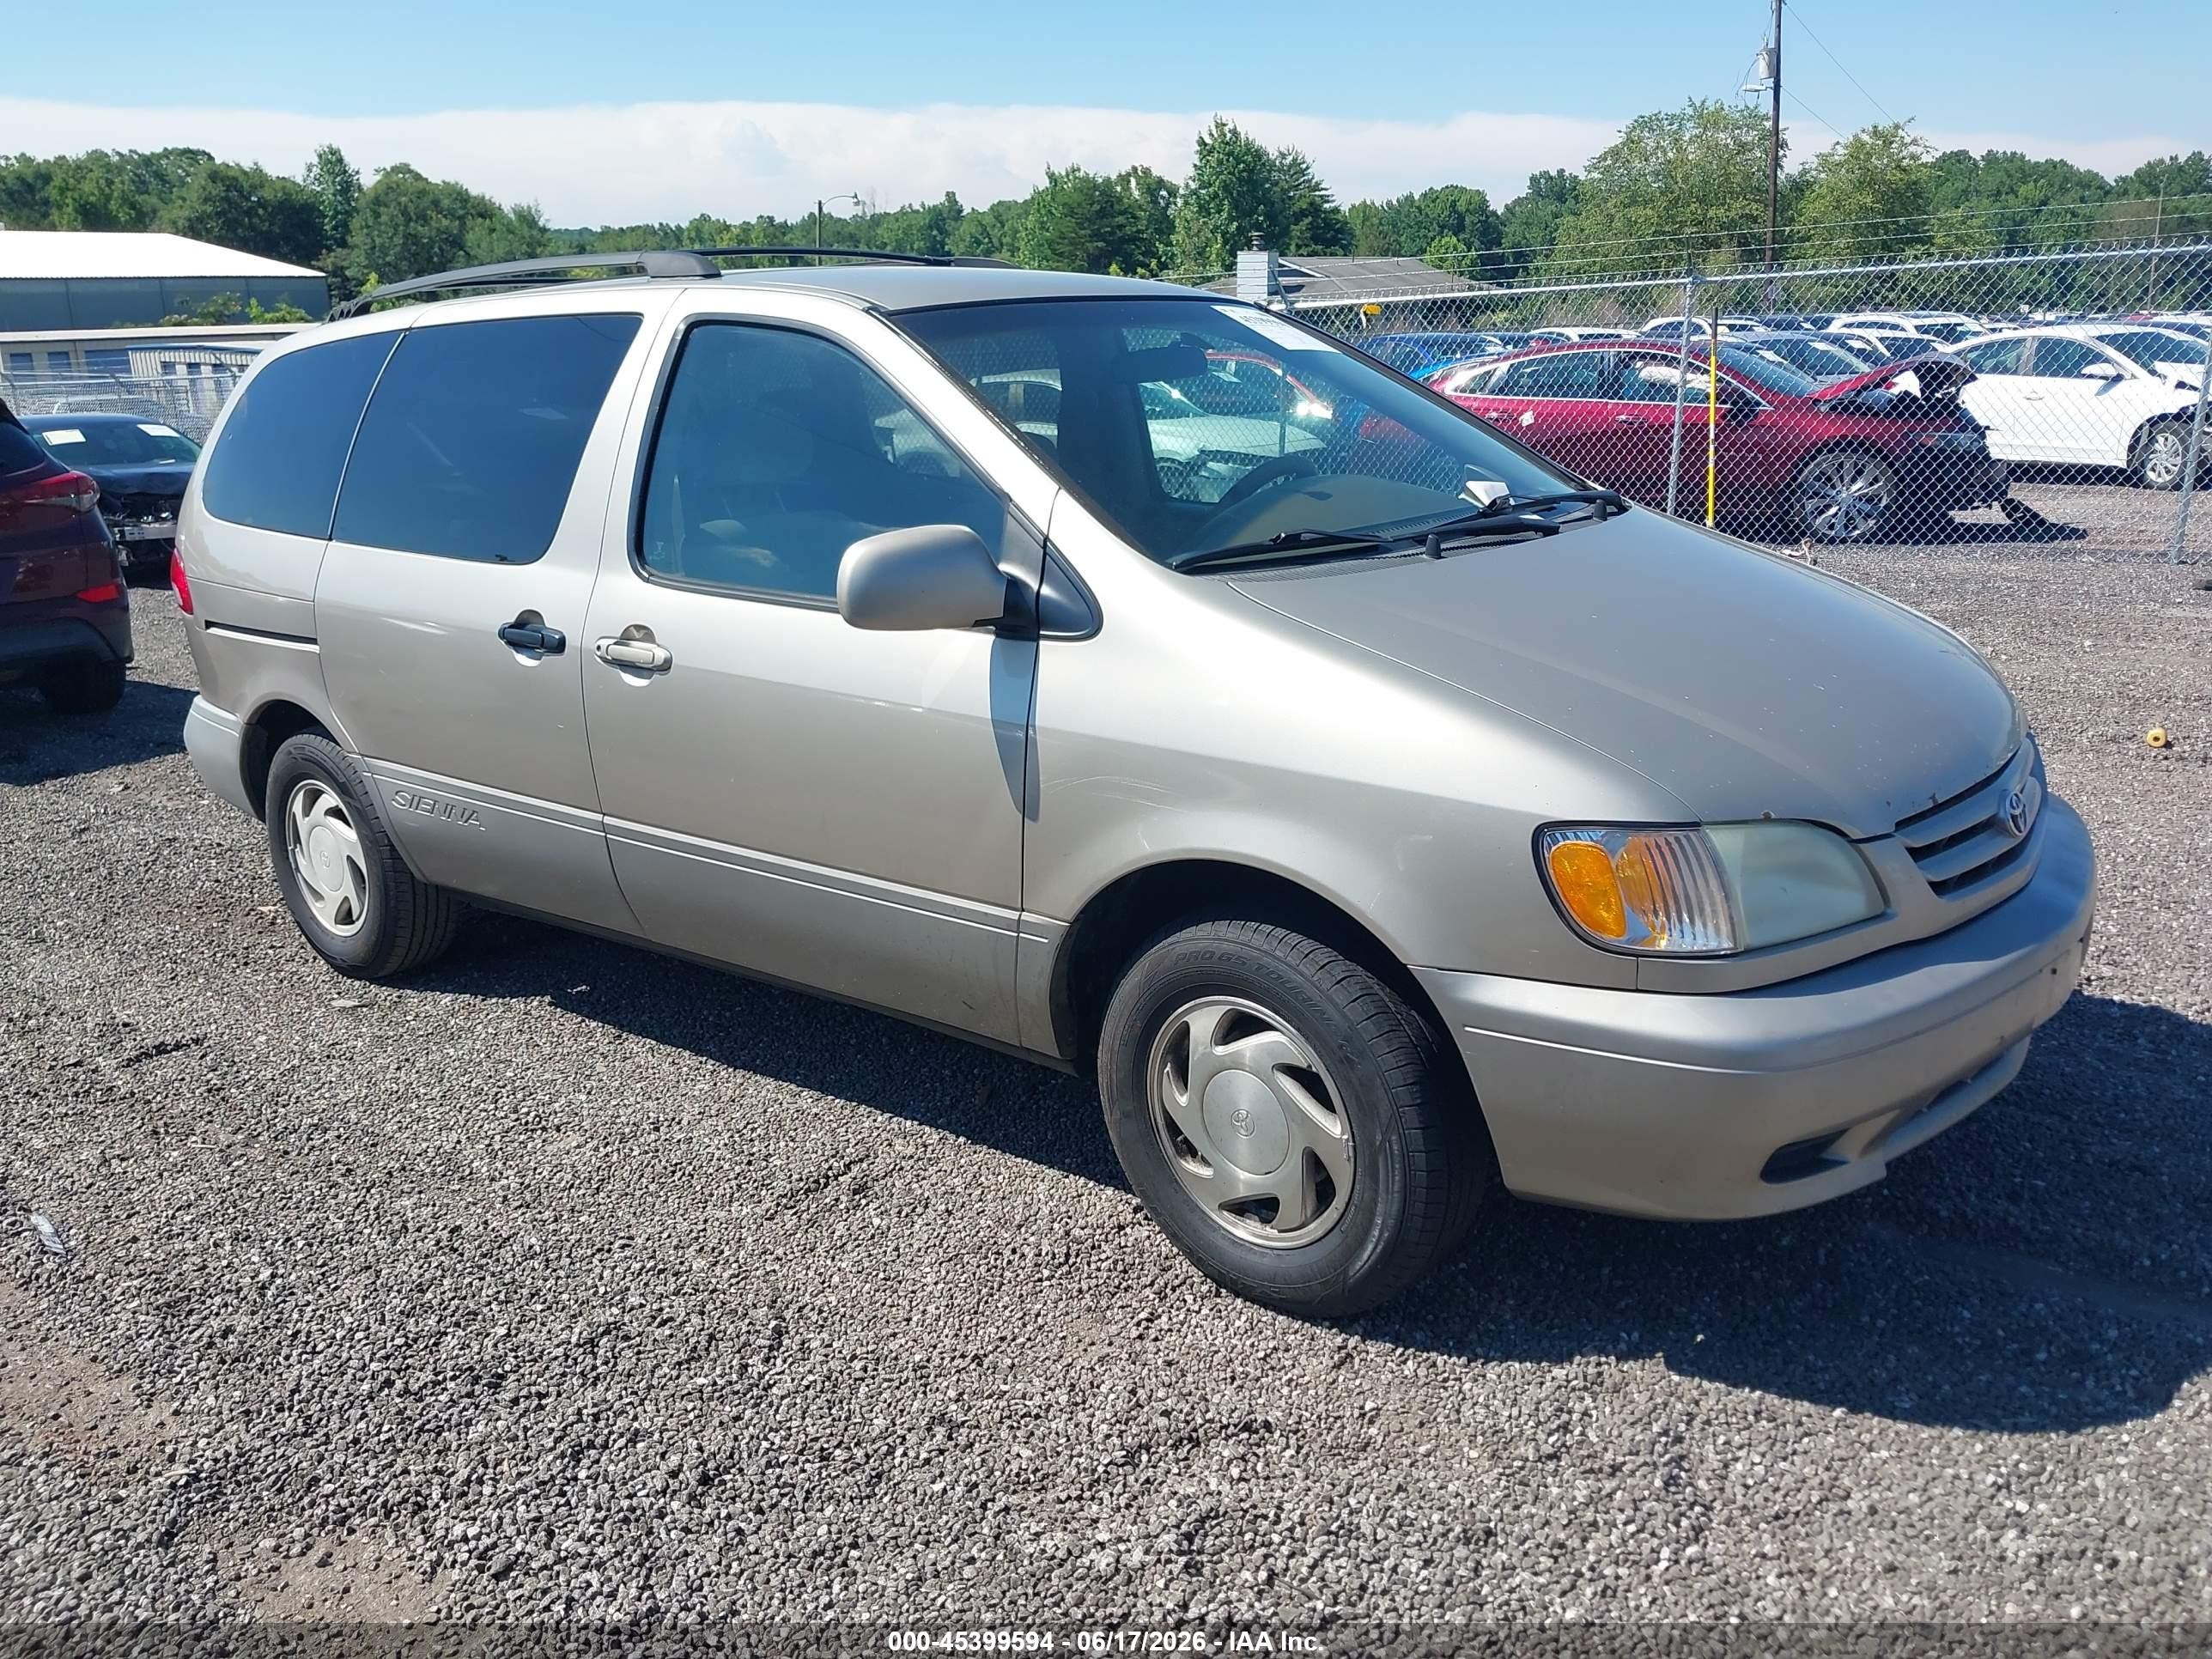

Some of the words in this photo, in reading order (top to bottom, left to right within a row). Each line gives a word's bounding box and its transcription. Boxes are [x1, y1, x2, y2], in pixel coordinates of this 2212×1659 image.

[391, 790, 486, 830] SIENNA
[1176, 950, 1216, 964] PRO
[1255, 962, 1338, 1027] TOURIN
